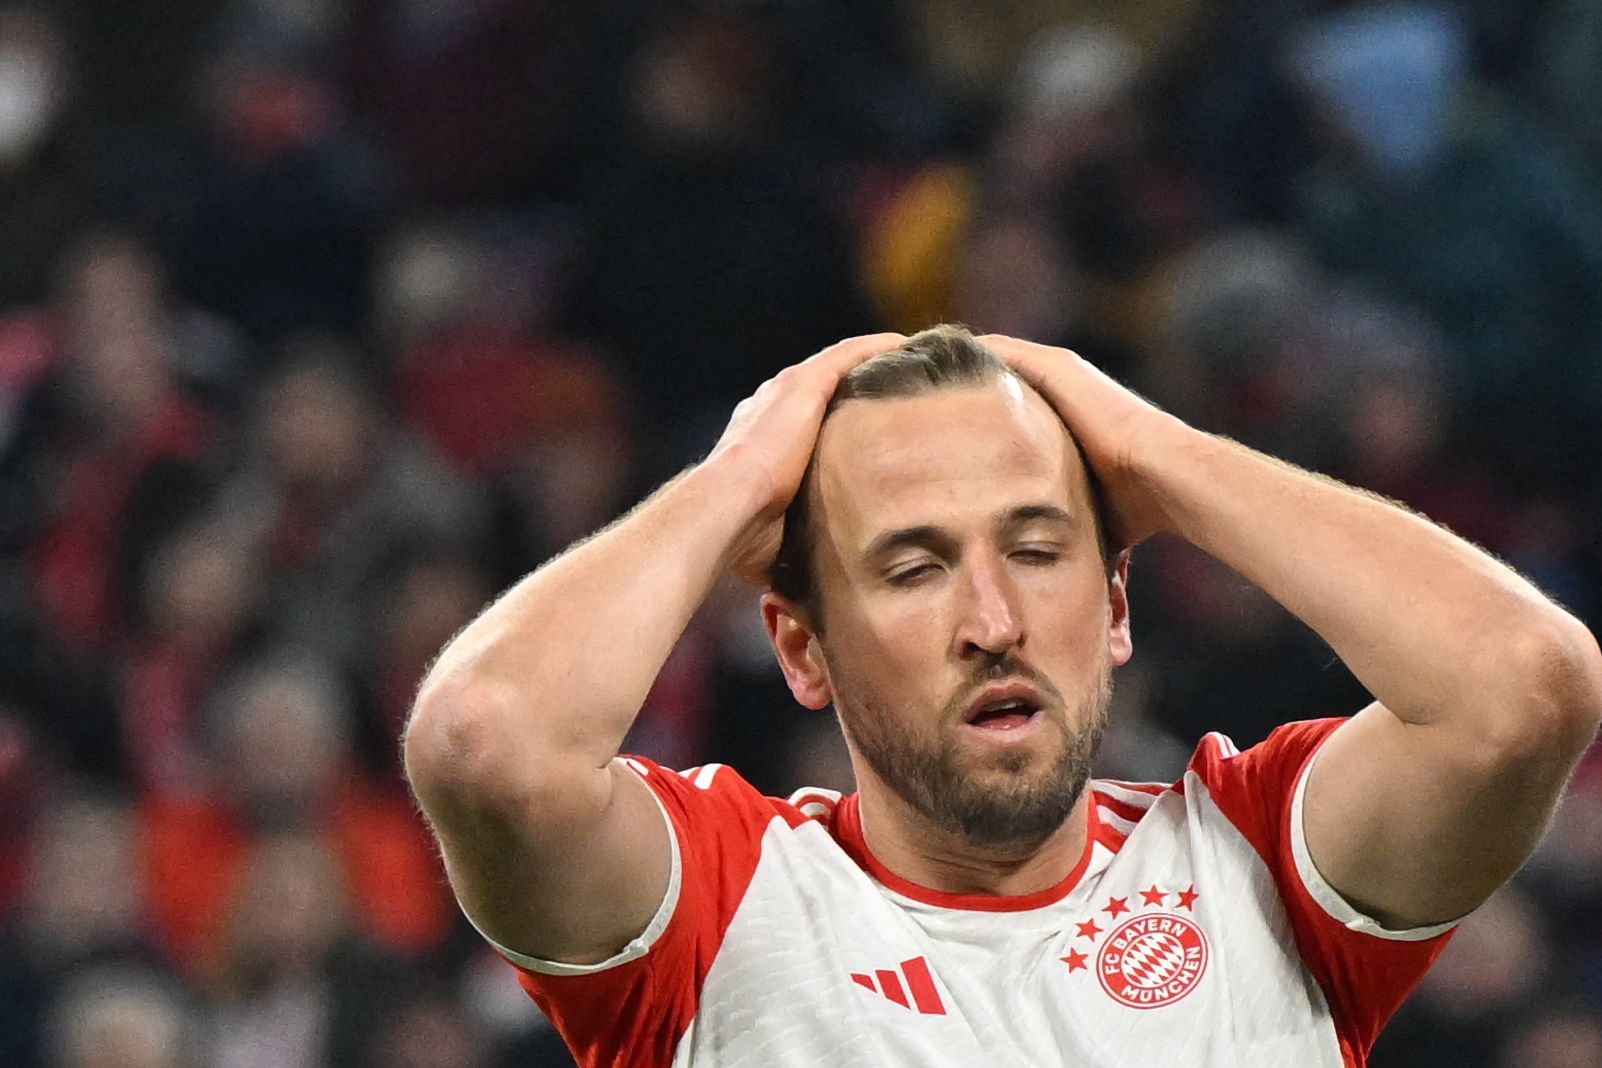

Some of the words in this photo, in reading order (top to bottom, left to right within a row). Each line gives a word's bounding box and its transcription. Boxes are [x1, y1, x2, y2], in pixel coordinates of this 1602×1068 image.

[1112, 918, 1187, 951] BAYERN
[1104, 952, 1121, 975] FC
[1120, 945, 1201, 1003] MÜNCHEN
